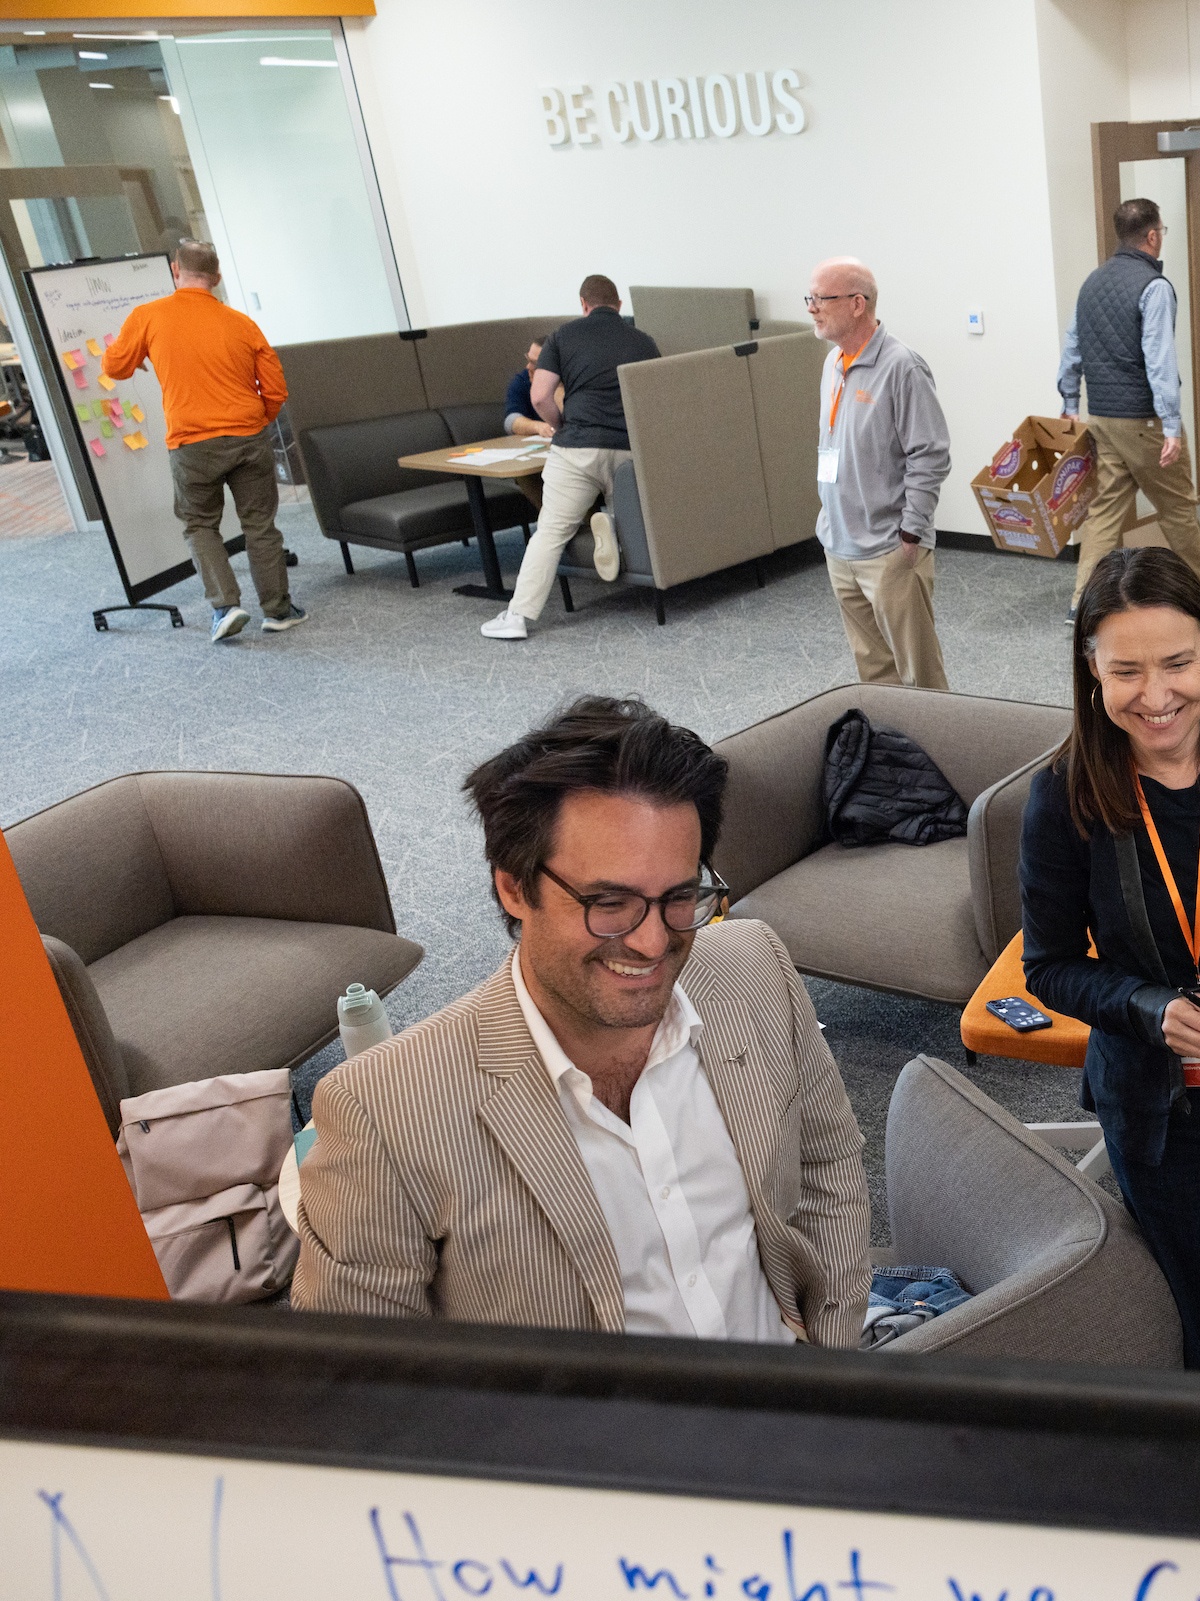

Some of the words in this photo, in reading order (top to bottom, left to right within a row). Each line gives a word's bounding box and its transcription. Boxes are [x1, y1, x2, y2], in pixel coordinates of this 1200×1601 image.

[539, 84, 599, 147] BE
[606, 67, 809, 144] CURIOUS
[1055, 461, 1082, 495] BONIPAK
[369, 1507, 564, 1601] How
[620, 1529, 895, 1601] might
